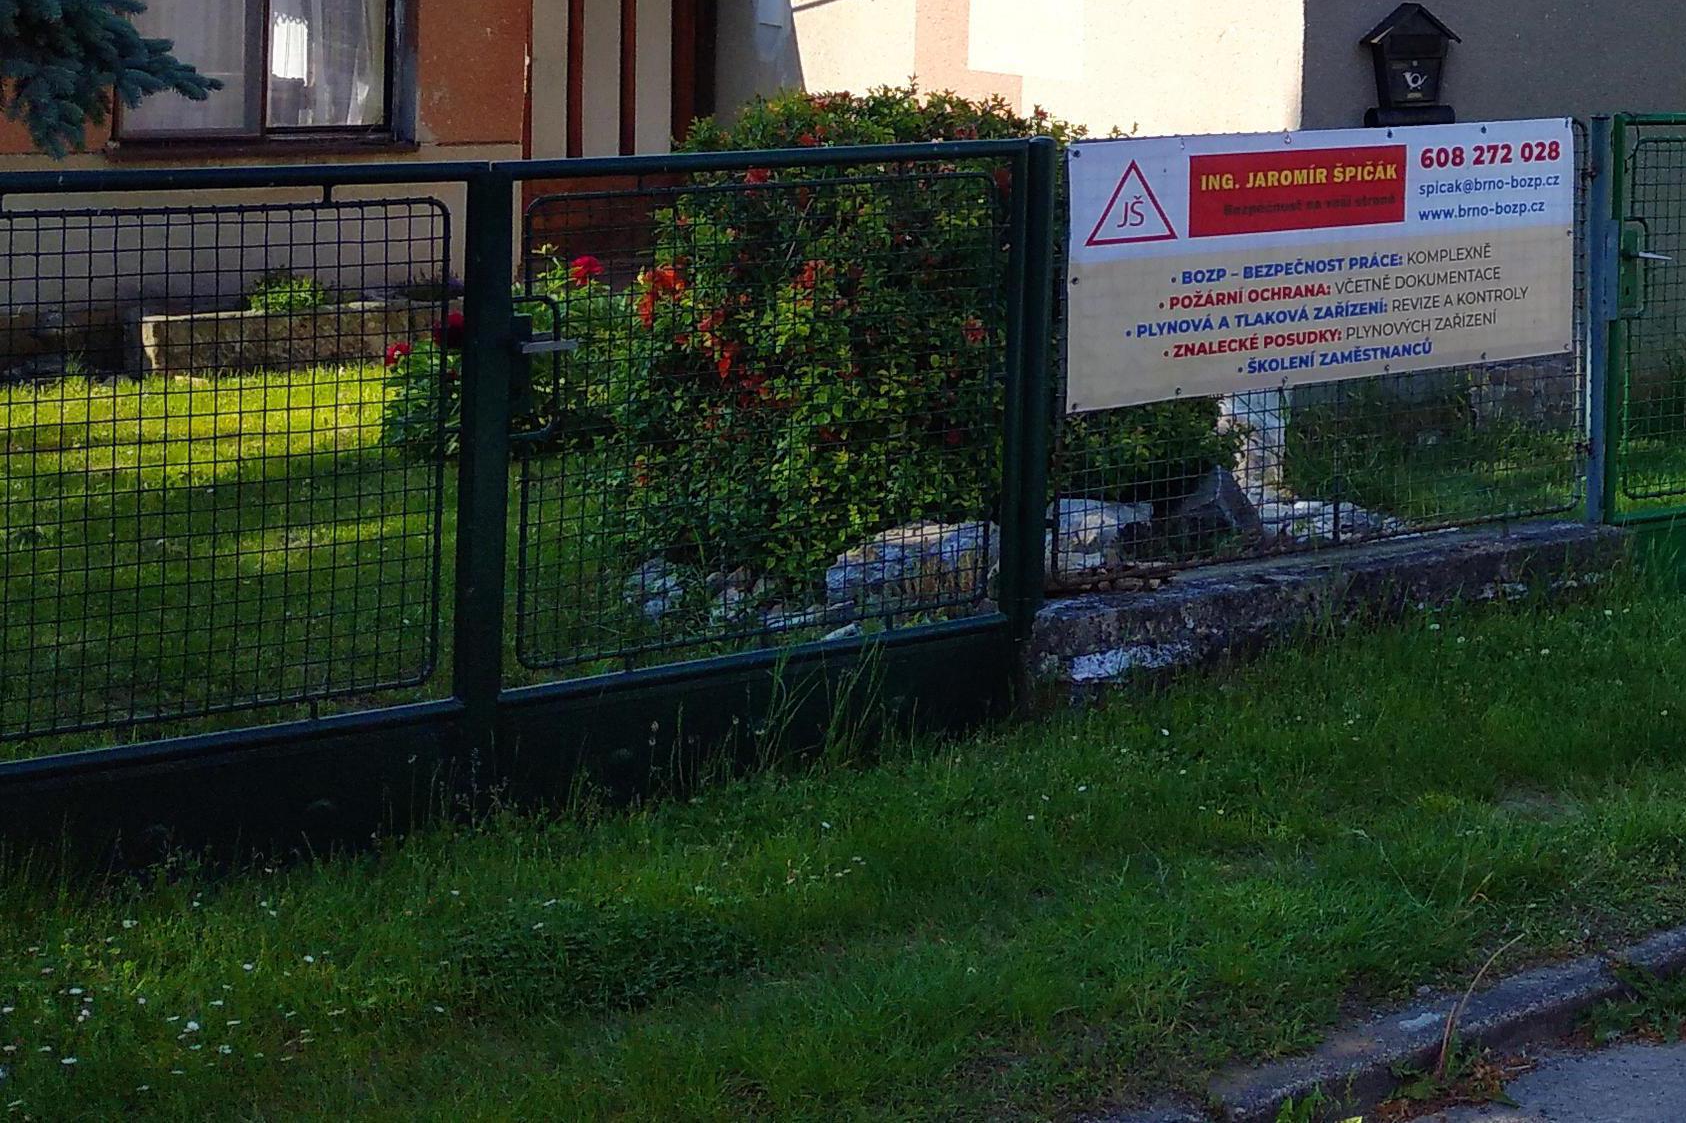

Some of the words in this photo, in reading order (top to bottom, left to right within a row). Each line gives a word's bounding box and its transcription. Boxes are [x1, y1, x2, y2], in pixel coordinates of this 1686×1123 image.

[1420, 146, 1465, 168] 608
[1472, 143, 1512, 166] 272
[1520, 140, 1561, 163] 028
[1201, 174, 1240, 191] ING.
[1246, 164, 1327, 188] JAROMÍR
[1333, 161, 1398, 182] ŠPIČÁK
[1419, 175, 1560, 198] spicak@brno-bozp.cz
[1117, 195, 1144, 228] JŠ
[1418, 201, 1545, 221] www.brno-bozp.cz
[1181, 268, 1226, 285] BOZP
[1243, 258, 1345, 279] BEZPEČNOST
[1350, 252, 1403, 270] PRÁCE:
[1407, 243, 1492, 265] KOMPLEXNĚ
[1169, 287, 1243, 310] POŽÁRNÍ
[1247, 283, 1331, 303] OCHRANA:
[1335, 275, 1391, 295] VČETNĚ
[1395, 266, 1501, 290] DOKUMENTACE
[1136, 313, 1214, 338] PLYNOVÁ
[1218, 315, 1230, 330] A
[1234, 305, 1309, 327] TLAKOVÁ
[1313, 297, 1388, 321] ZAŘÍZENÍ:
[1392, 294, 1440, 313] REVIZE
[1443, 294, 1454, 307] A
[1457, 286, 1529, 306] KONTROLY
[1173, 333, 1259, 359] ZNALECKÉ
[1263, 328, 1342, 349] POSUDKY:
[1346, 318, 1430, 340] PLYNOVÝCH
[1434, 309, 1497, 331] ZAŘÍZENÍ
[1247, 351, 1315, 374] ŠKOLENÍ
[1319, 337, 1433, 367] ZAMĚSTNANCŮ
